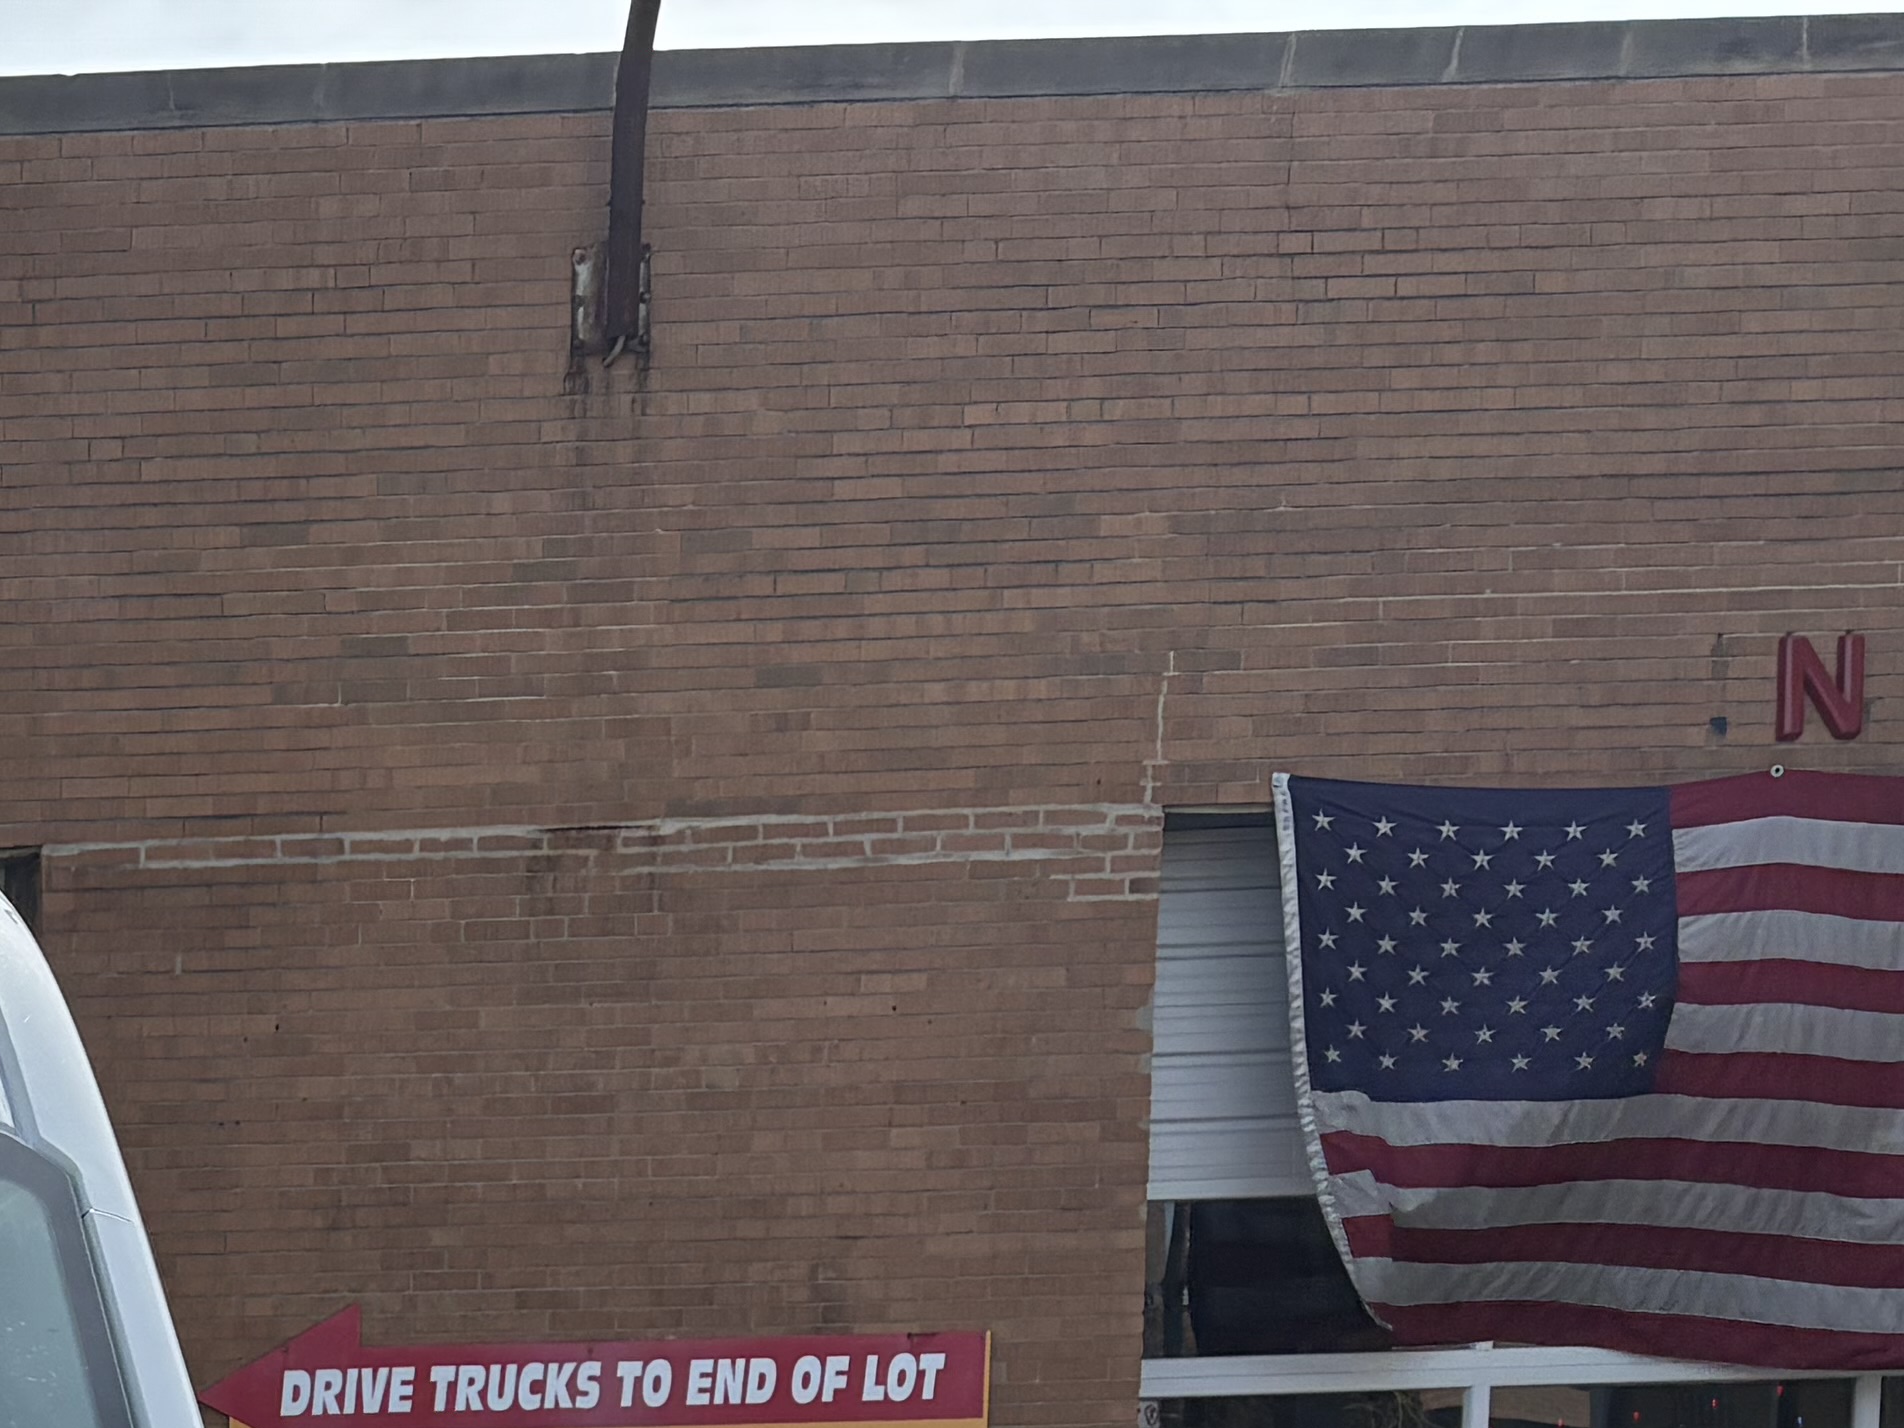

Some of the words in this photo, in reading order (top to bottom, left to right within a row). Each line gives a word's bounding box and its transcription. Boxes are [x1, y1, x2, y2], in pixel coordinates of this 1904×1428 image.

[1775, 633, 1866, 743] N
[280, 1366, 415, 1417] DRIVE
[429, 1360, 601, 1414] TRUCKS
[617, 1358, 672, 1408] TO
[685, 1356, 777, 1406] END
[792, 1354, 851, 1404] OF
[861, 1352, 946, 1402] LOT
